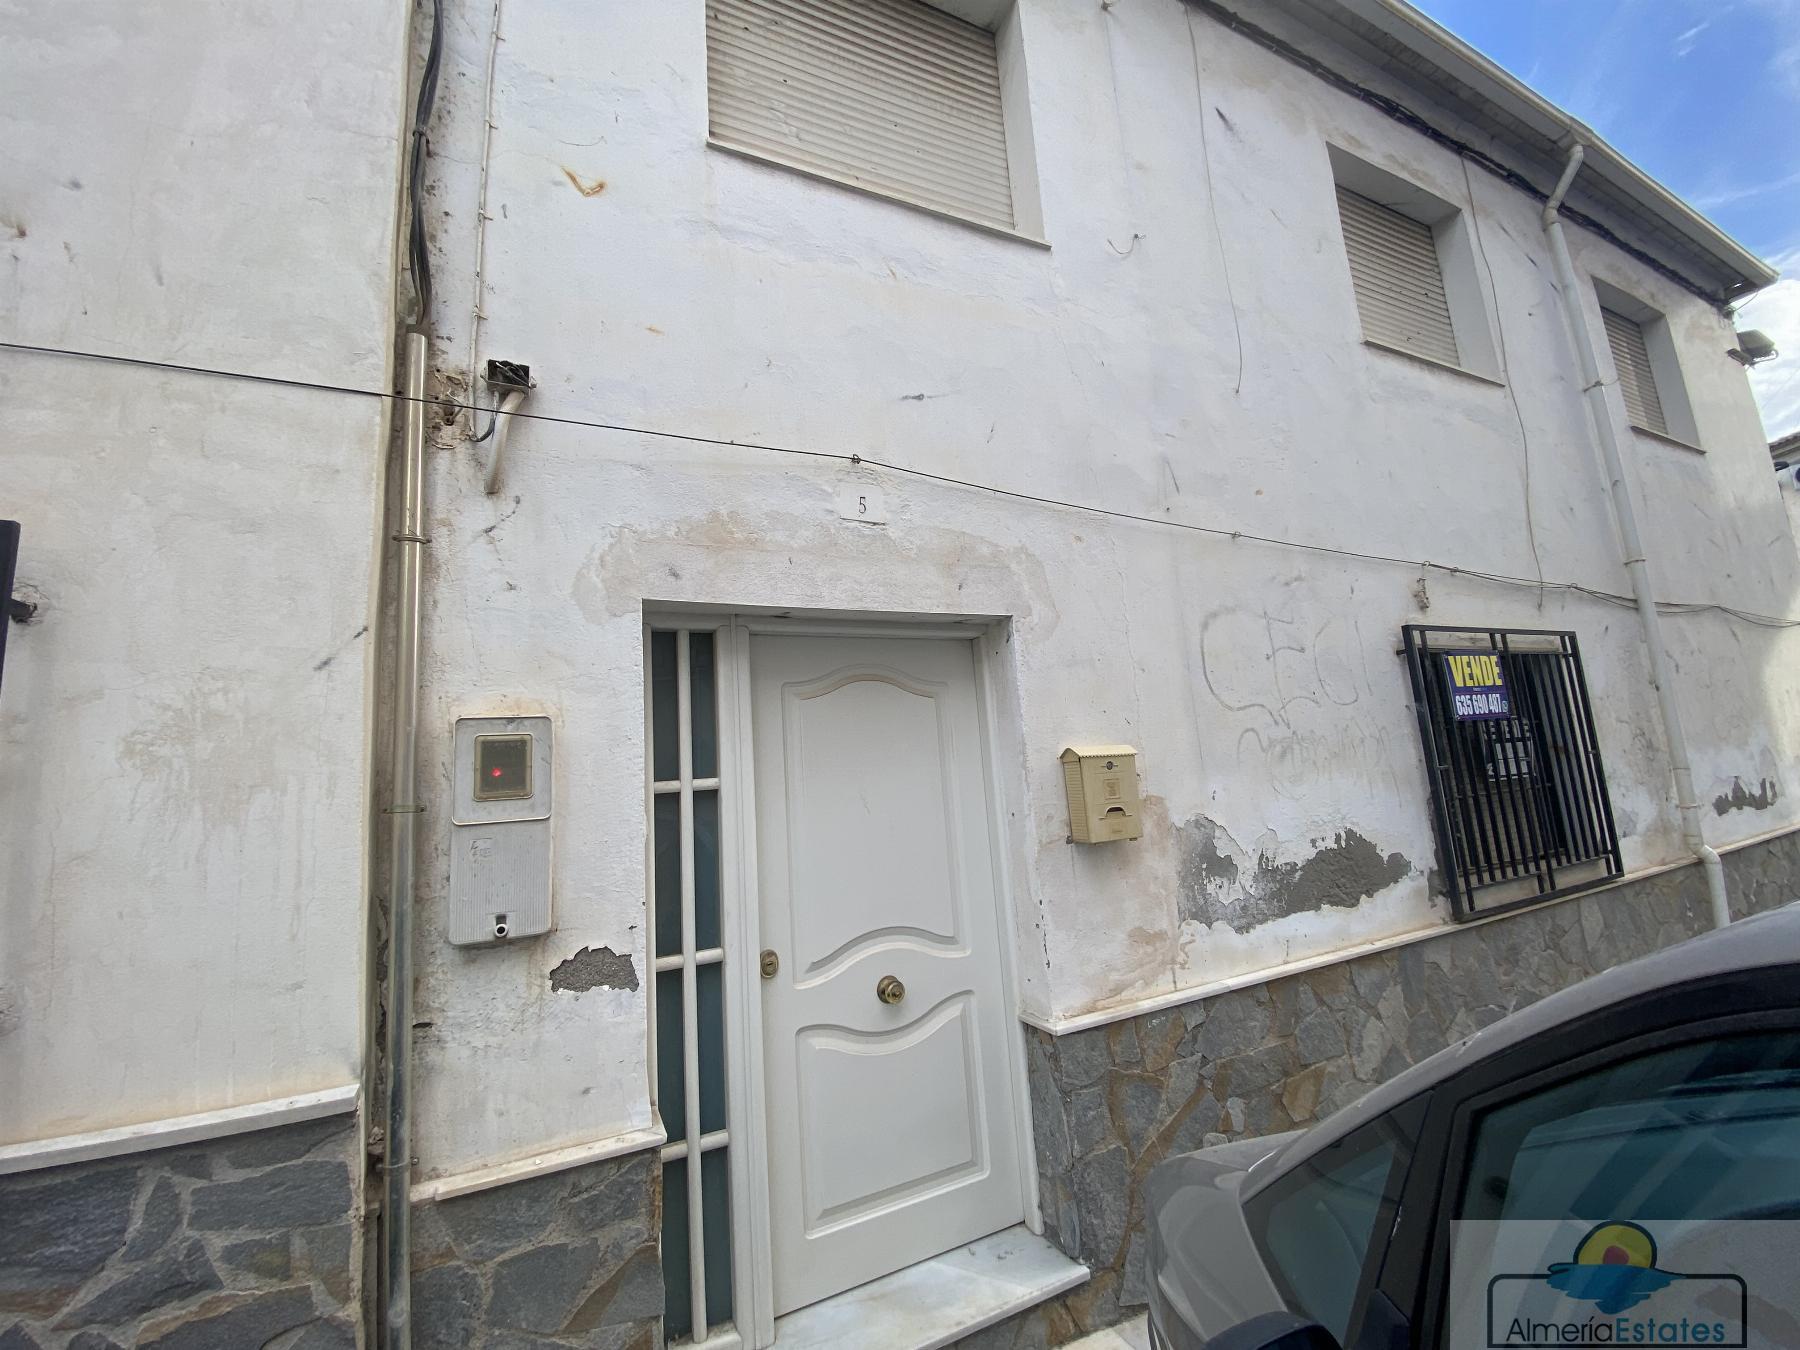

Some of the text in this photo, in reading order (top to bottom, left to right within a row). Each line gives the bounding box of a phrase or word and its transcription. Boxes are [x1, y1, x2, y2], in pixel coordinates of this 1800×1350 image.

[859, 496, 866, 514] 5
[1447, 655, 1503, 687] VENDE
[1455, 695, 1473, 716] 635
[1472, 694, 1489, 715] 690
